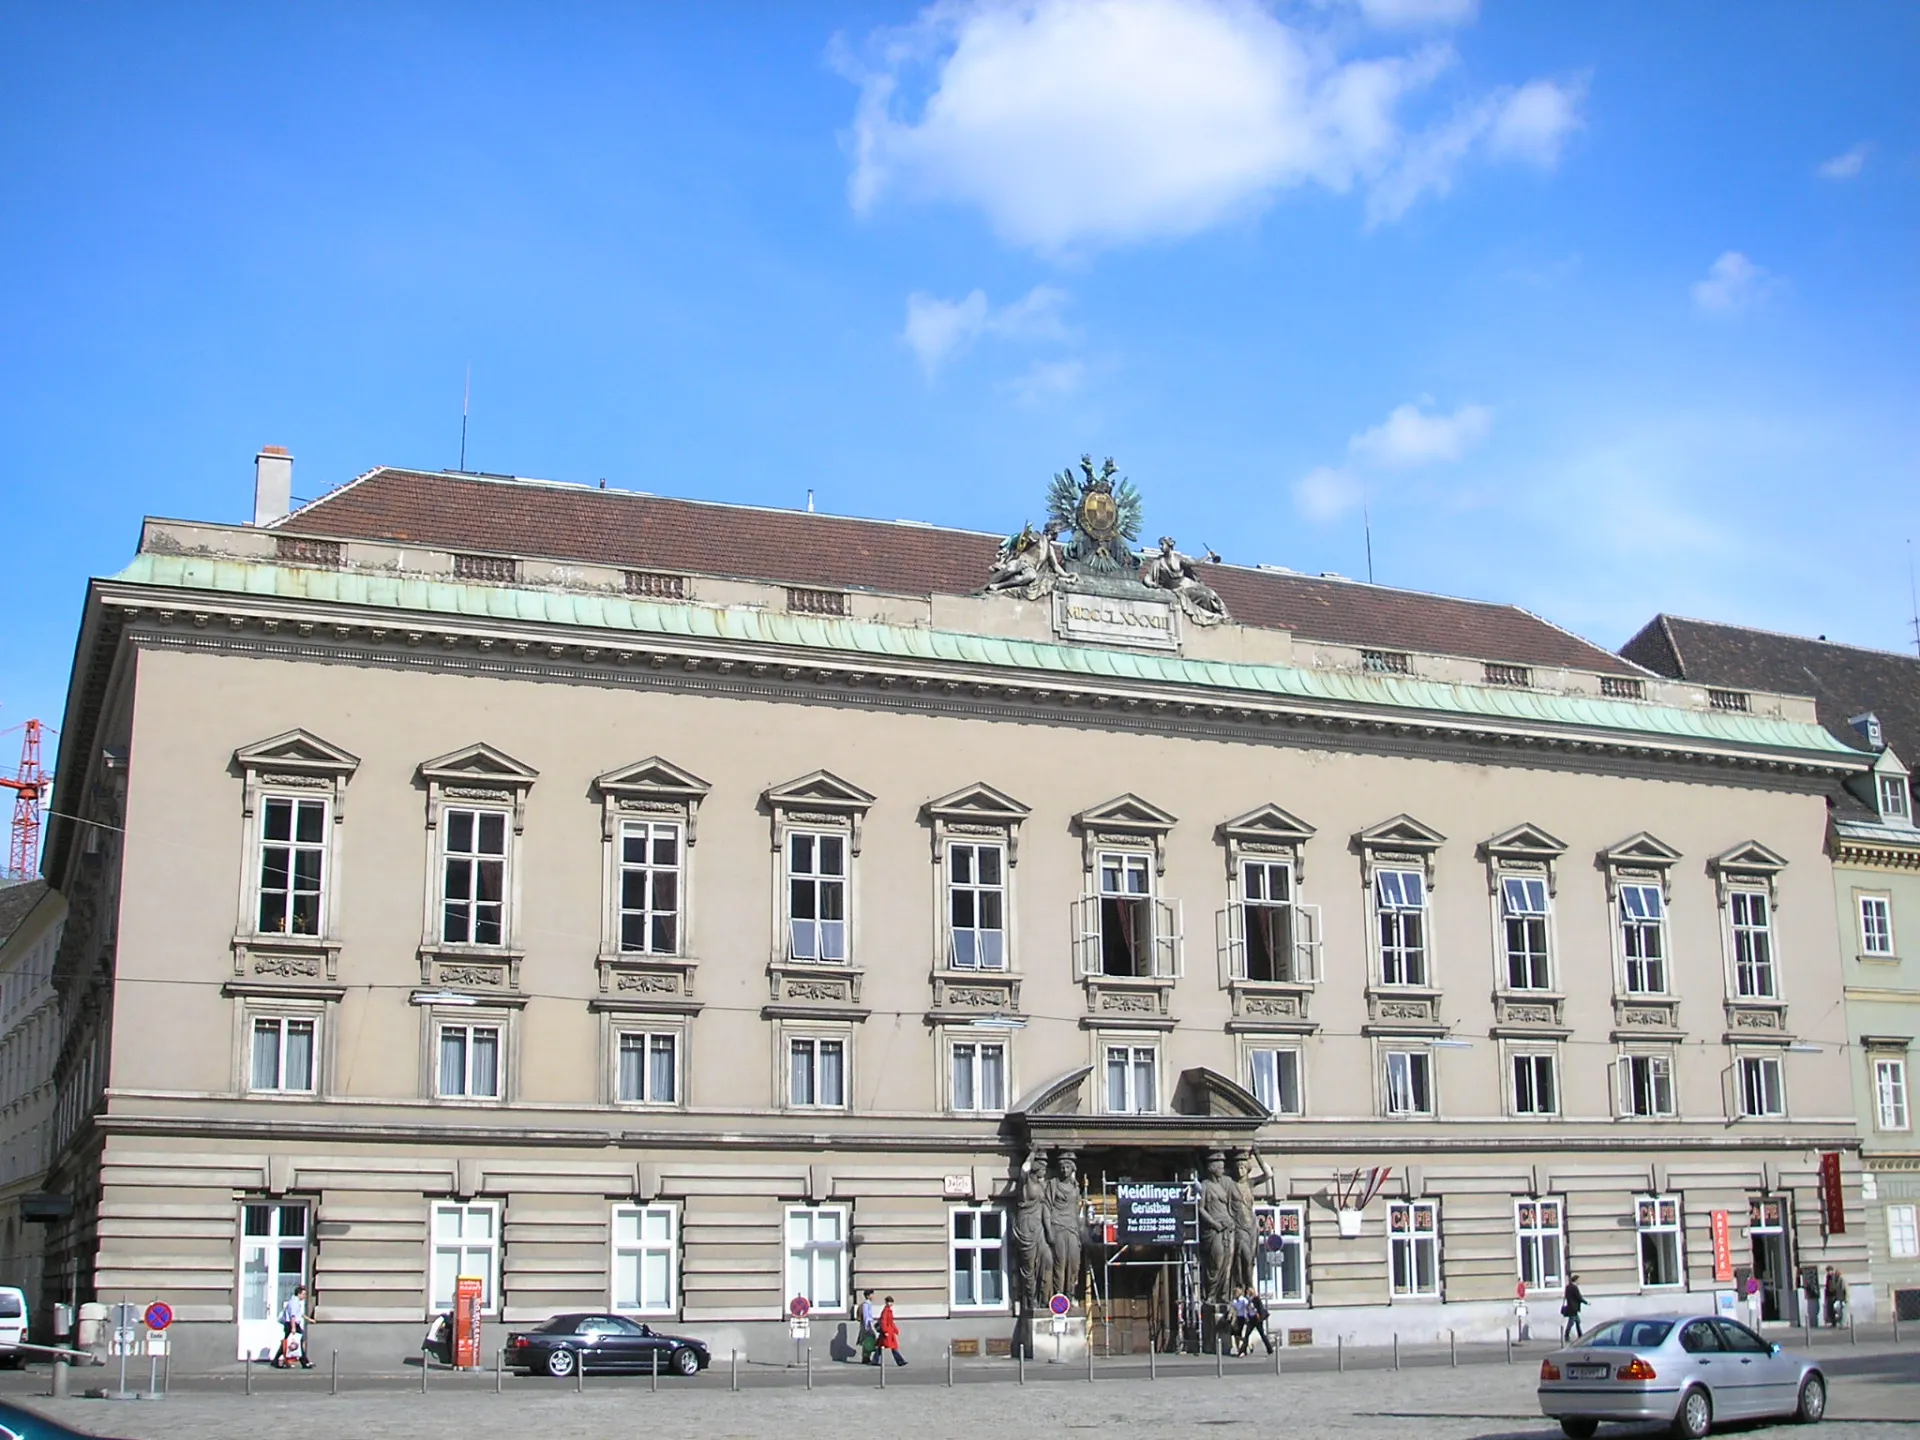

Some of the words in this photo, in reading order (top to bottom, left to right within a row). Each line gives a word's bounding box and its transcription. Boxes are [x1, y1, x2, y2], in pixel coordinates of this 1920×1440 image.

[1117, 1184, 1181, 1202] Meidlinger
[1131, 1201, 1171, 1214] Gerüstbau
[1717, 1212, 1726, 1269] ARTCAFE
